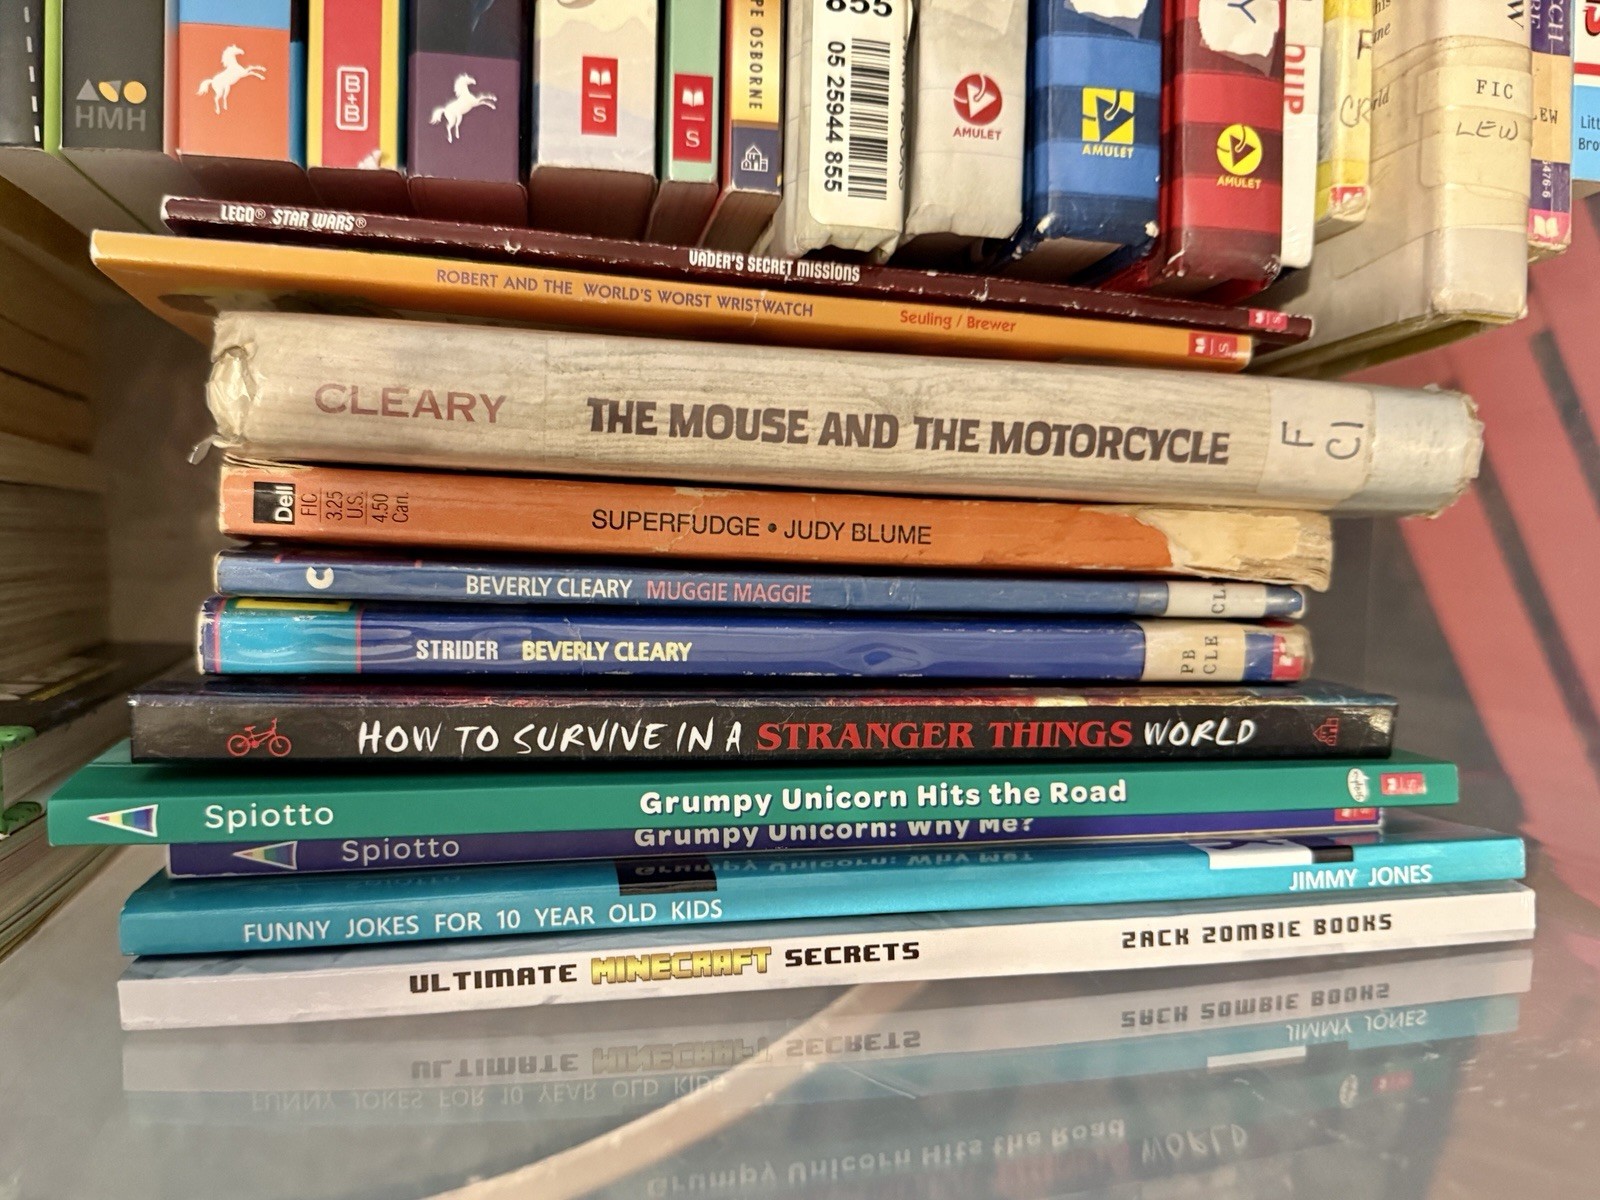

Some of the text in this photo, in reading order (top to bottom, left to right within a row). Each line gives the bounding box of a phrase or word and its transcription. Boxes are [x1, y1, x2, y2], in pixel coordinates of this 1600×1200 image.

[749, 27, 764, 110] OSBORNE
[1476, 79, 1513, 99] FIC
[75, 106, 147, 132] HMH
[824, 41, 846, 193] 05 25944 855
[1456, 121, 1518, 141] LEW
[952, 126, 1002, 141] AMULET
[1082, 143, 1134, 159] AMULET
[1216, 175, 1262, 189] AMULET
[272, 209, 309, 228] STAR
[747, 253, 793, 276] SECRET
[437, 269, 814, 317] ROBERT AND THE WORLD'S WORST WRISTWATCH
[900, 309, 952, 331] Seuling
[966, 316, 1017, 333] Brewer
[314, 382, 507, 424] CLEARY
[586, 397, 1230, 466] THE MOUSE AND THE MOTORCYCLE
[1282, 421, 1314, 447] F
[275, 485, 294, 522] Dell
[301, 493, 318, 516] FIC
[326, 491, 343, 521] 3.25
[347, 492, 364, 519] U.S.
[372, 493, 388, 523] 4.50
[392, 492, 409, 523] Can.
[592, 509, 932, 545] SUPERFUDGE JUDY BLUME
[466, 575, 812, 604] BEVERLY CLEARY MUGGIE MAGGIE
[1211, 584, 1227, 614] CL
[416, 639, 692, 662] STRIDER BEVERLY CLEARY
[1181, 649, 1196, 675] PB
[1203, 635, 1219, 675] CLE
[357, 718, 1257, 755] HOW TO SURVIVE IN A STRANGER THINGS WORLD
[204, 779, 1127, 834] Spiotto Grumpy Unicorn Hits the Road
[341, 838, 460, 867] Spiotto
[634, 826, 759, 848] Grumpy
[243, 864, 1433, 943] FUNNY JOKES FOR 10 YEAR OLD KIDS JIMMY JONES
[409, 913, 1392, 994] ULTIMATE MINECRAFT SECRETS ZACK ZOMBIE BOOKS
